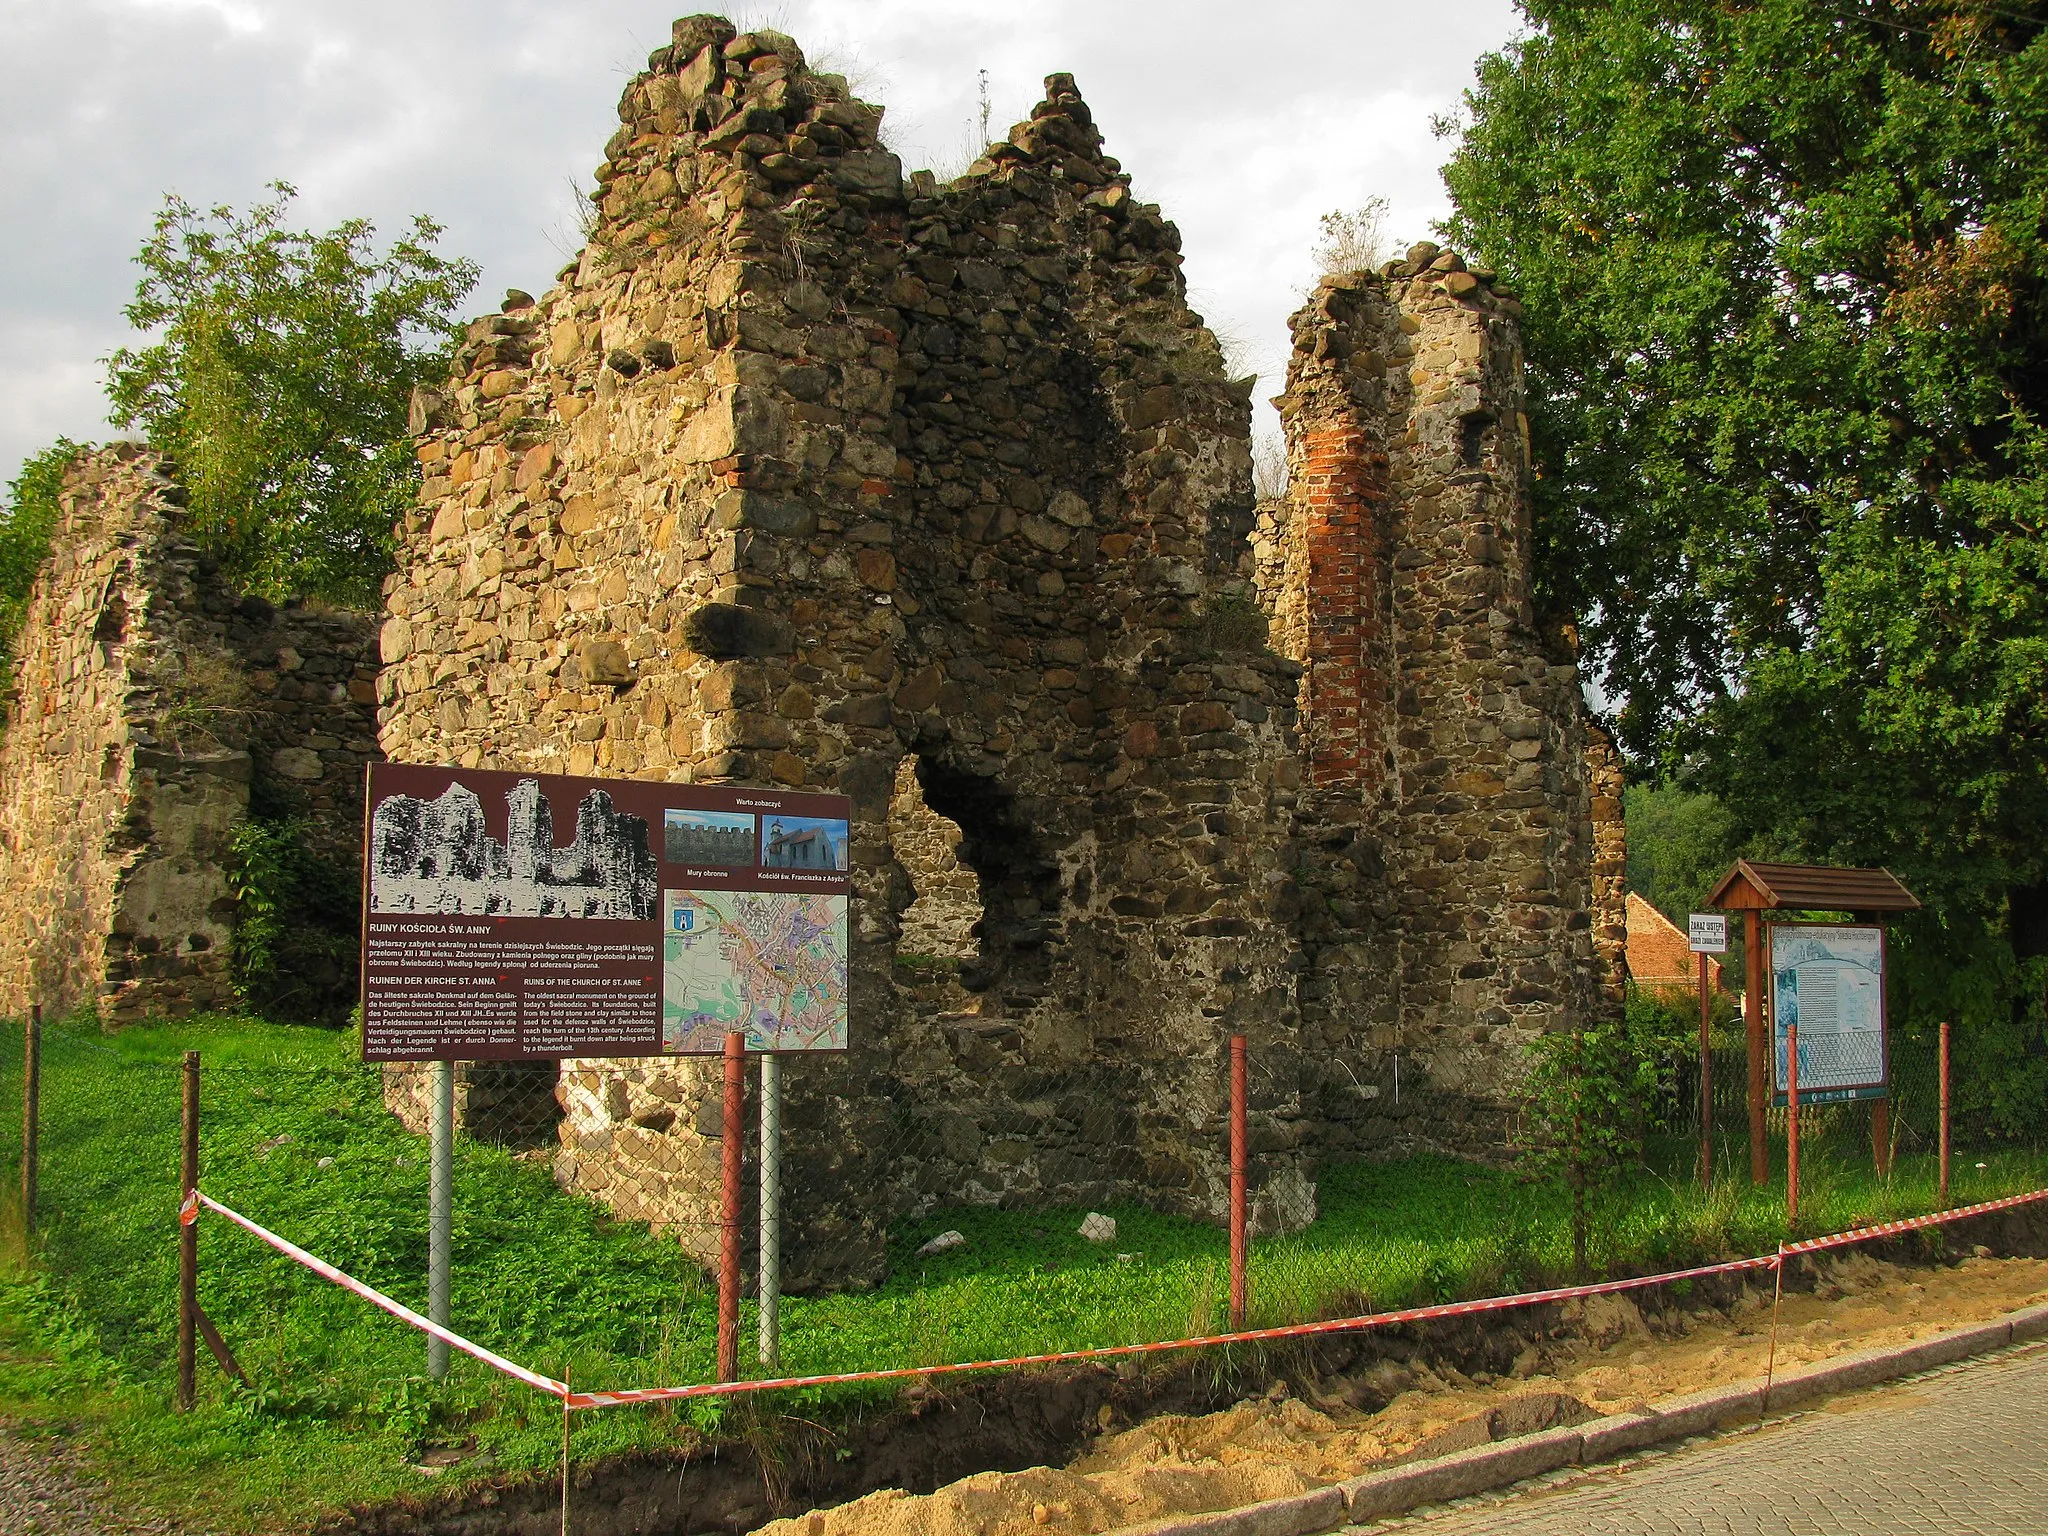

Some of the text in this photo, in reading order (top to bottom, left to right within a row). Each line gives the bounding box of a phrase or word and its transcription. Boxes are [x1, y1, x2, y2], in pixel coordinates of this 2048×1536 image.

[736, 798, 781, 809] Warto zobaczyć
[687, 869, 702, 878] Mury
[792, 873, 822, 881] Franciszka
[370, 923, 490, 934] RUINY KOŚCIOŁA ŚW. ANNY
[1691, 921, 1706, 930] ZAKAZ
[369, 940, 406, 949] Najstarszy
[409, 940, 436, 950] zabytek
[438, 941, 467, 950] sakralny
[479, 941, 502, 949] terenie
[504, 942, 544, 951] dzisiejszych
[546, 941, 584, 950] Świebodzic.
[586, 943, 602, 952] Jego
[604, 943, 630, 952] początki
[632, 944, 654, 953] sięgają
[432, 950, 454, 958] wieku.
[456, 951, 495, 960] Zbudowany
[502, 951, 531, 959] kamienia
[533, 952, 559, 961] polnego
[576, 952, 592, 961] gliny
[594, 952, 626, 962] (podobnie
[627, 953, 636, 962] jak
[638, 954, 654, 962] mury
[401, 958, 445, 969] Świebodzic).
[447, 960, 472, 969] Według
[474, 960, 501, 969] legendy
[573, 961, 600, 970] pioruna.
[369, 976, 495, 985] RUINEN DER KIRCHE ST. ANNA
[524, 978, 641, 987] RUINS OF THE CHURCH OF ST. ANNE
[628, 992, 649, 1001] ground
[379, 1001, 410, 1010] heutigen
[411, 999, 456, 1008] Świebodzice.
[474, 1001, 498, 1010] Beginn
[550, 999, 588, 1008] Świebodzice.
[603, 1001, 639, 1010] foundations,
[597, 1009, 609, 1018] clay
[368, 1028, 442, 1037] Verteidigungsmauern
[444, 1026, 486, 1035] Świebodzice
[601, 1026, 624, 1036] century.
[626, 1026, 655, 1035] According
[407, 1037, 437, 1046] Legende
[542, 1035, 563, 1044] legend
[620, 1035, 636, 1044] being
[368, 1046, 434, 1055] schlag abgebrannt.
[523, 1044, 530, 1054] by
